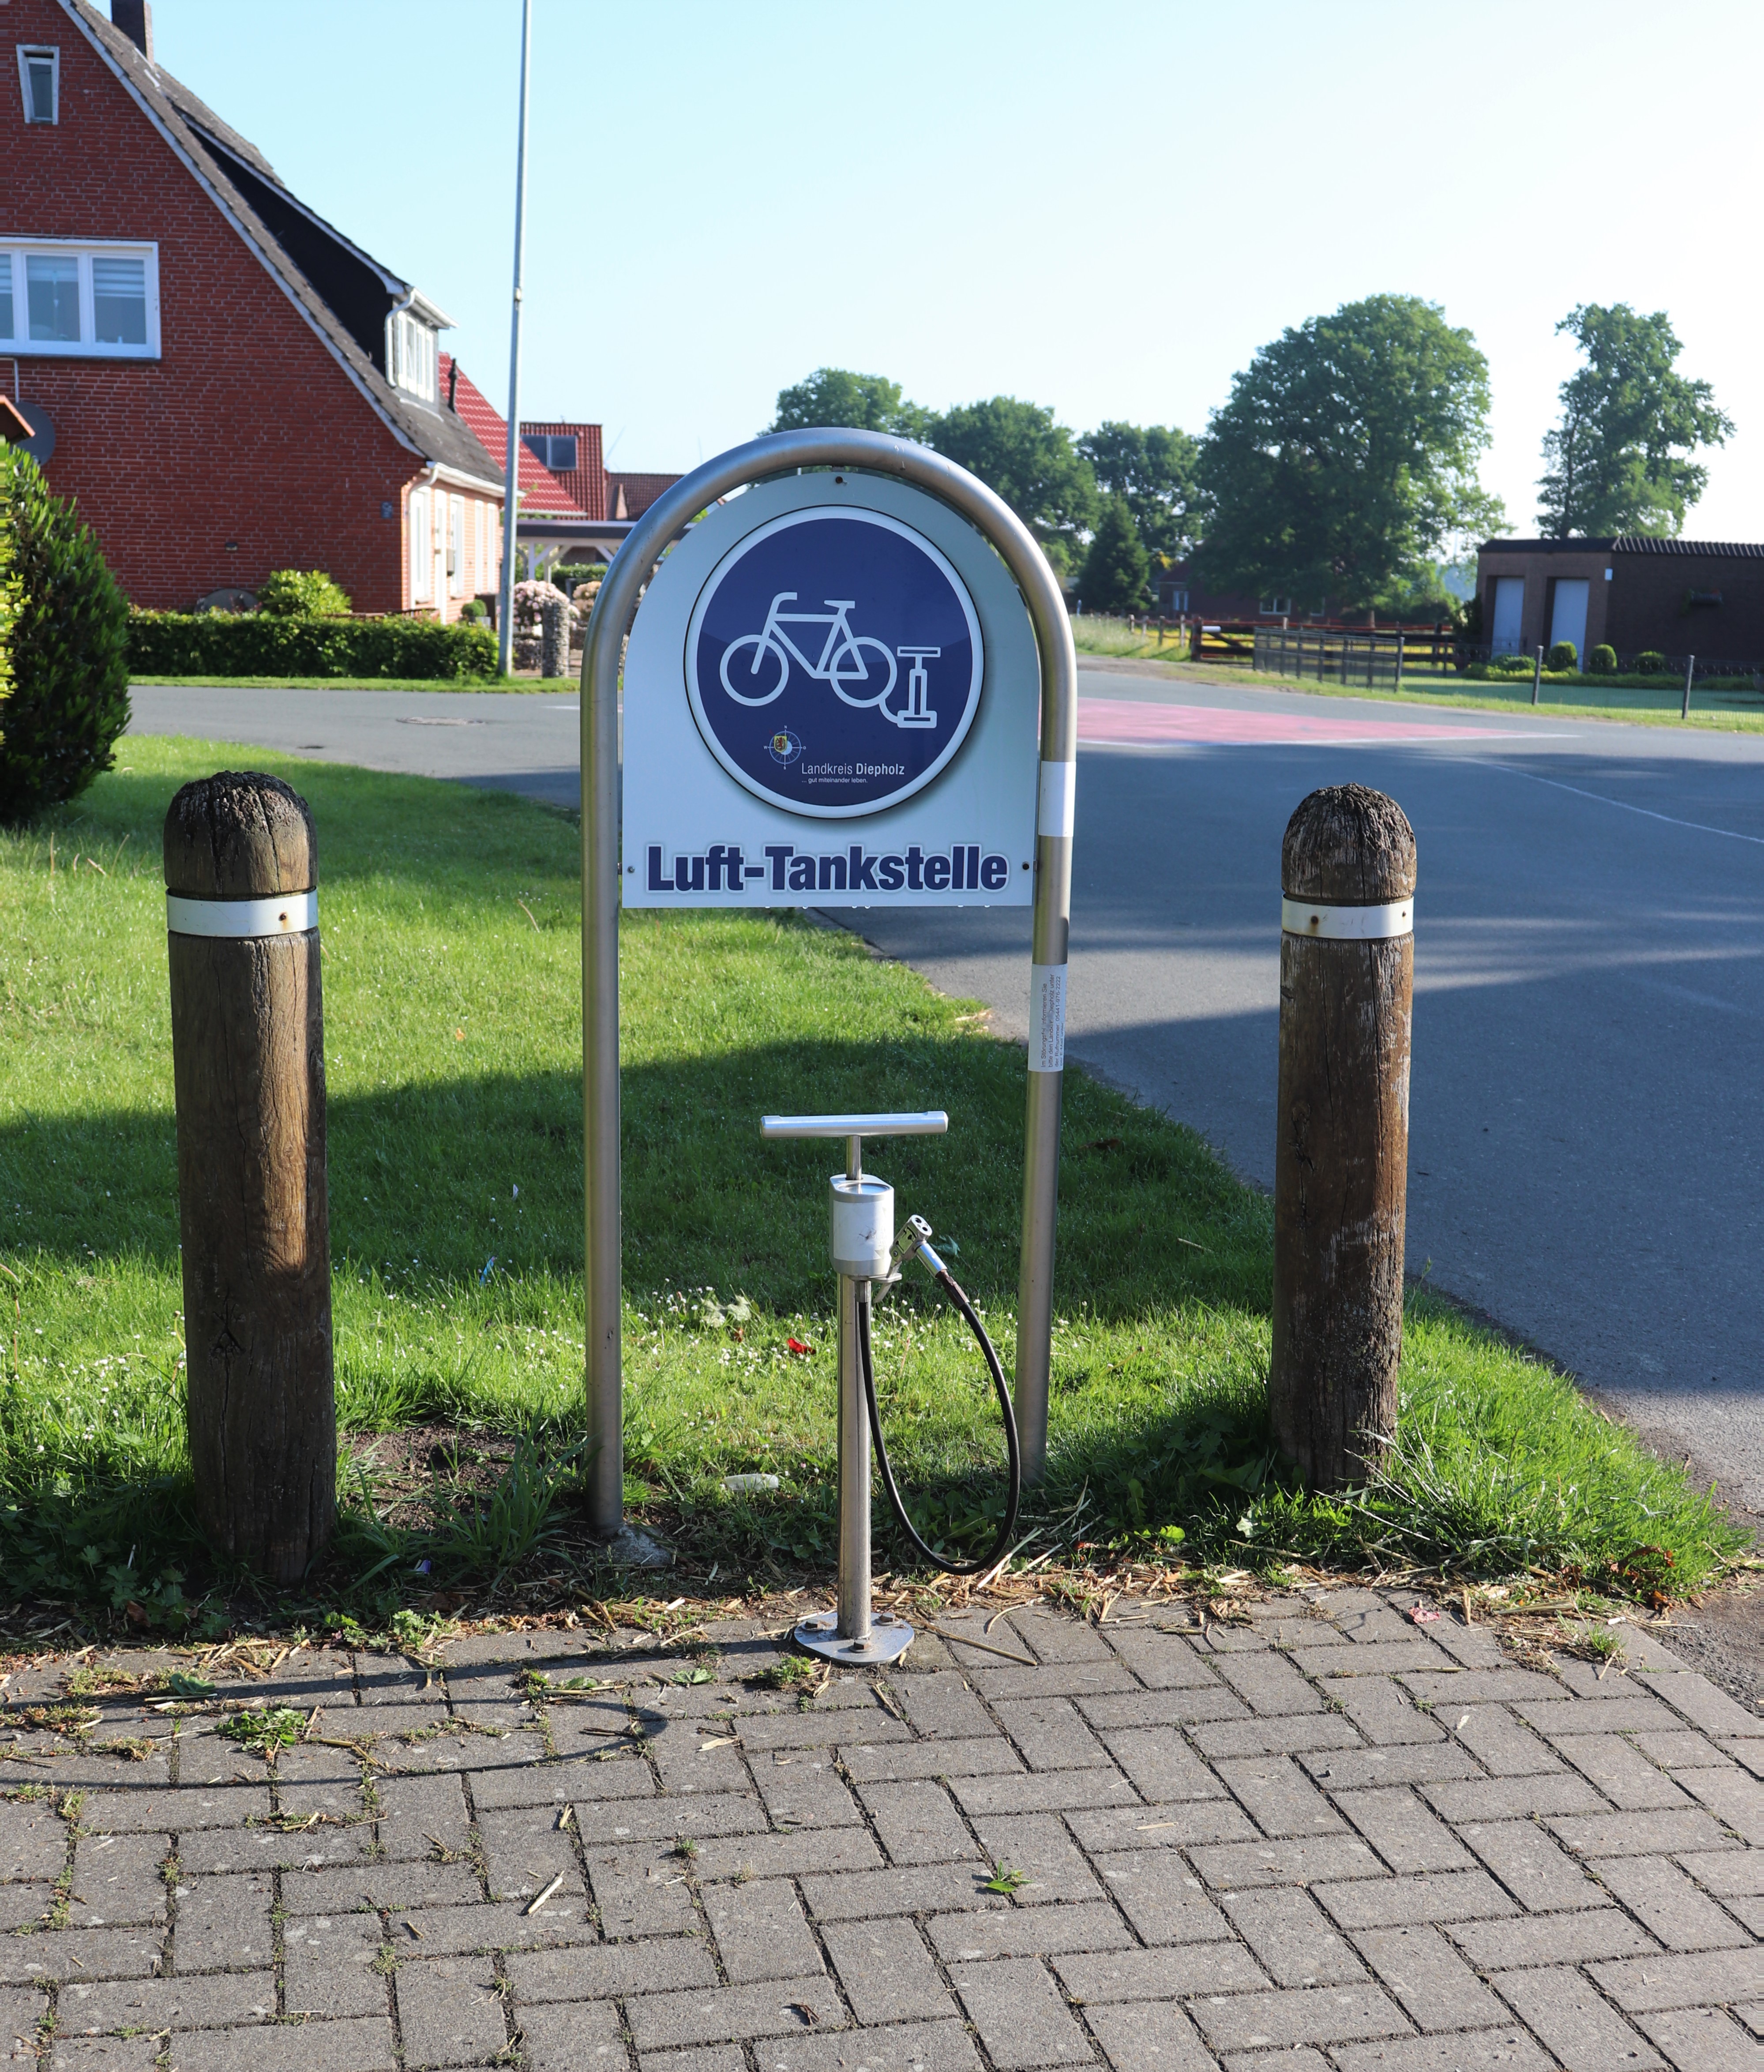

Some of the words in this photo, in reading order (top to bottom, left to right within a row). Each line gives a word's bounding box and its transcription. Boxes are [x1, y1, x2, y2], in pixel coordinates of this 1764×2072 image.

[802, 763, 852, 775] Landkreis
[856, 763, 905, 777] Diepholz
[647, 845, 1008, 891] Luft-Tankstelle
